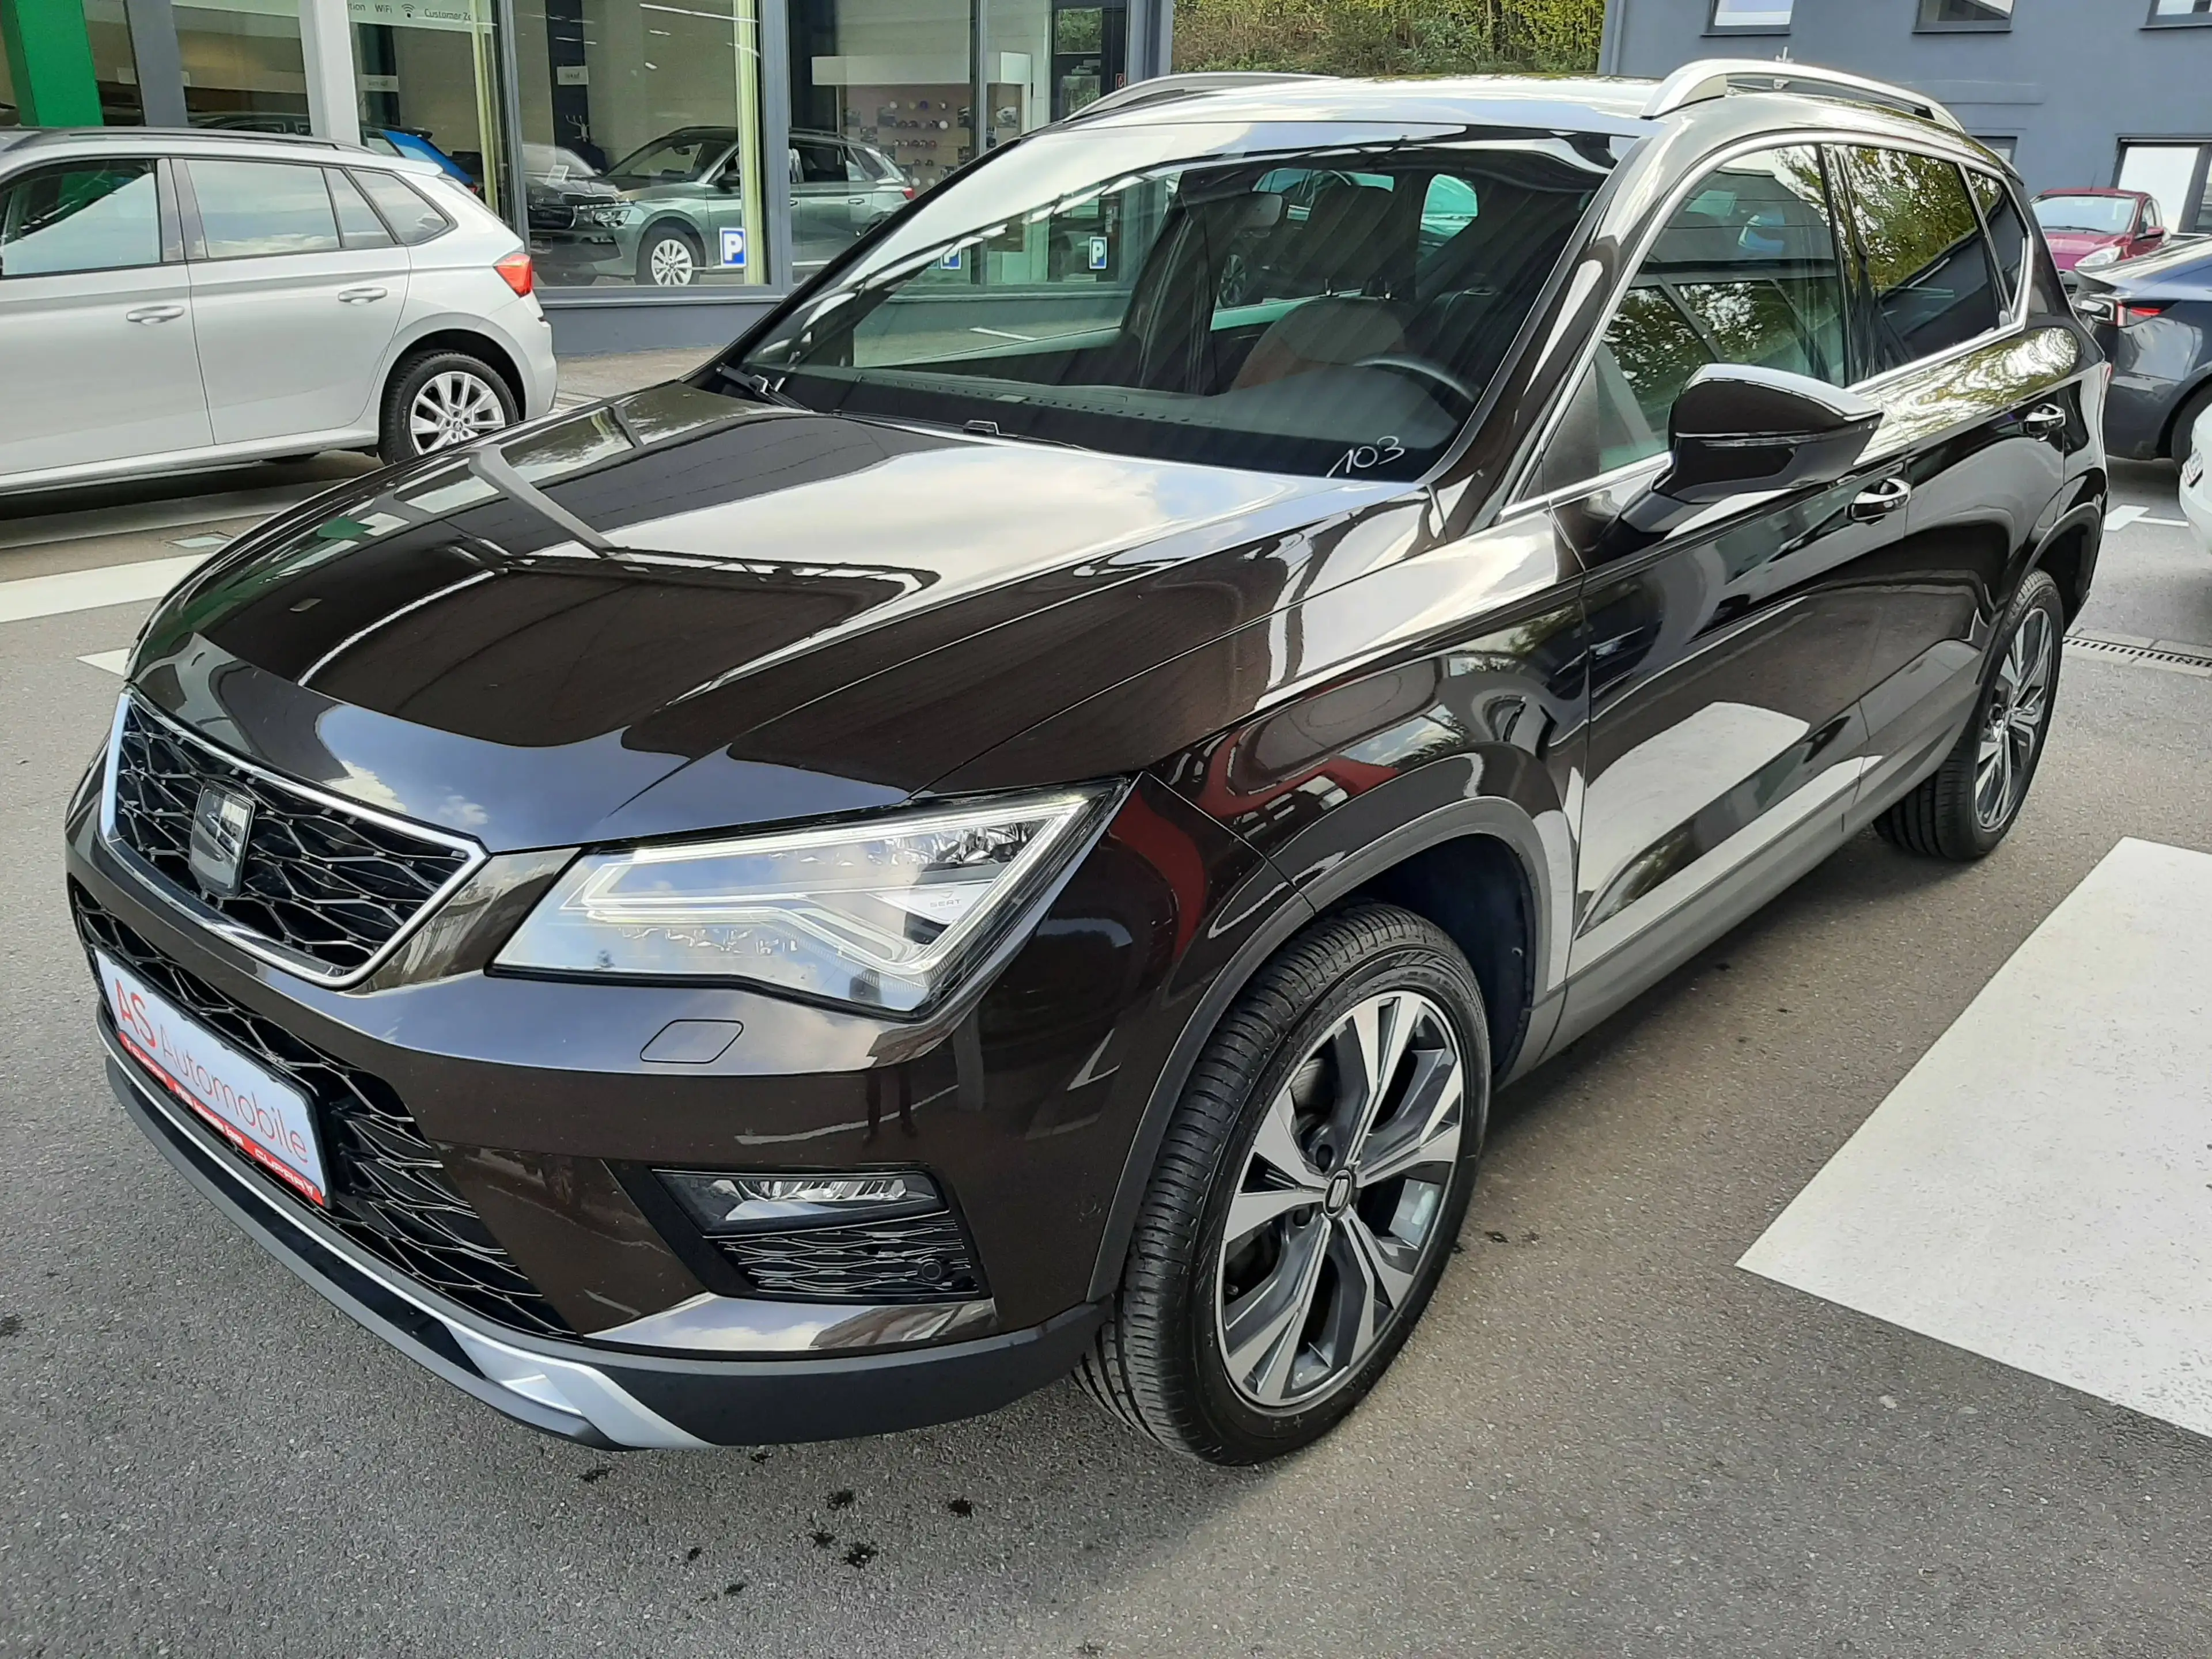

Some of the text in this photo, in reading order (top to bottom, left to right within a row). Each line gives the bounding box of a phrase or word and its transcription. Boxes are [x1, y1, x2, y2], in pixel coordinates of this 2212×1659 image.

[374, 4, 392, 13] WiFi
[425, 9, 461, 20] Customer
[724, 233, 743, 261] P
[1092, 241, 1104, 264] P
[1325, 435, 1405, 478] 103
[930, 899, 961, 908] SEAT
[115, 978, 156, 1048] AS
[160, 1024, 308, 1163] Automobile
